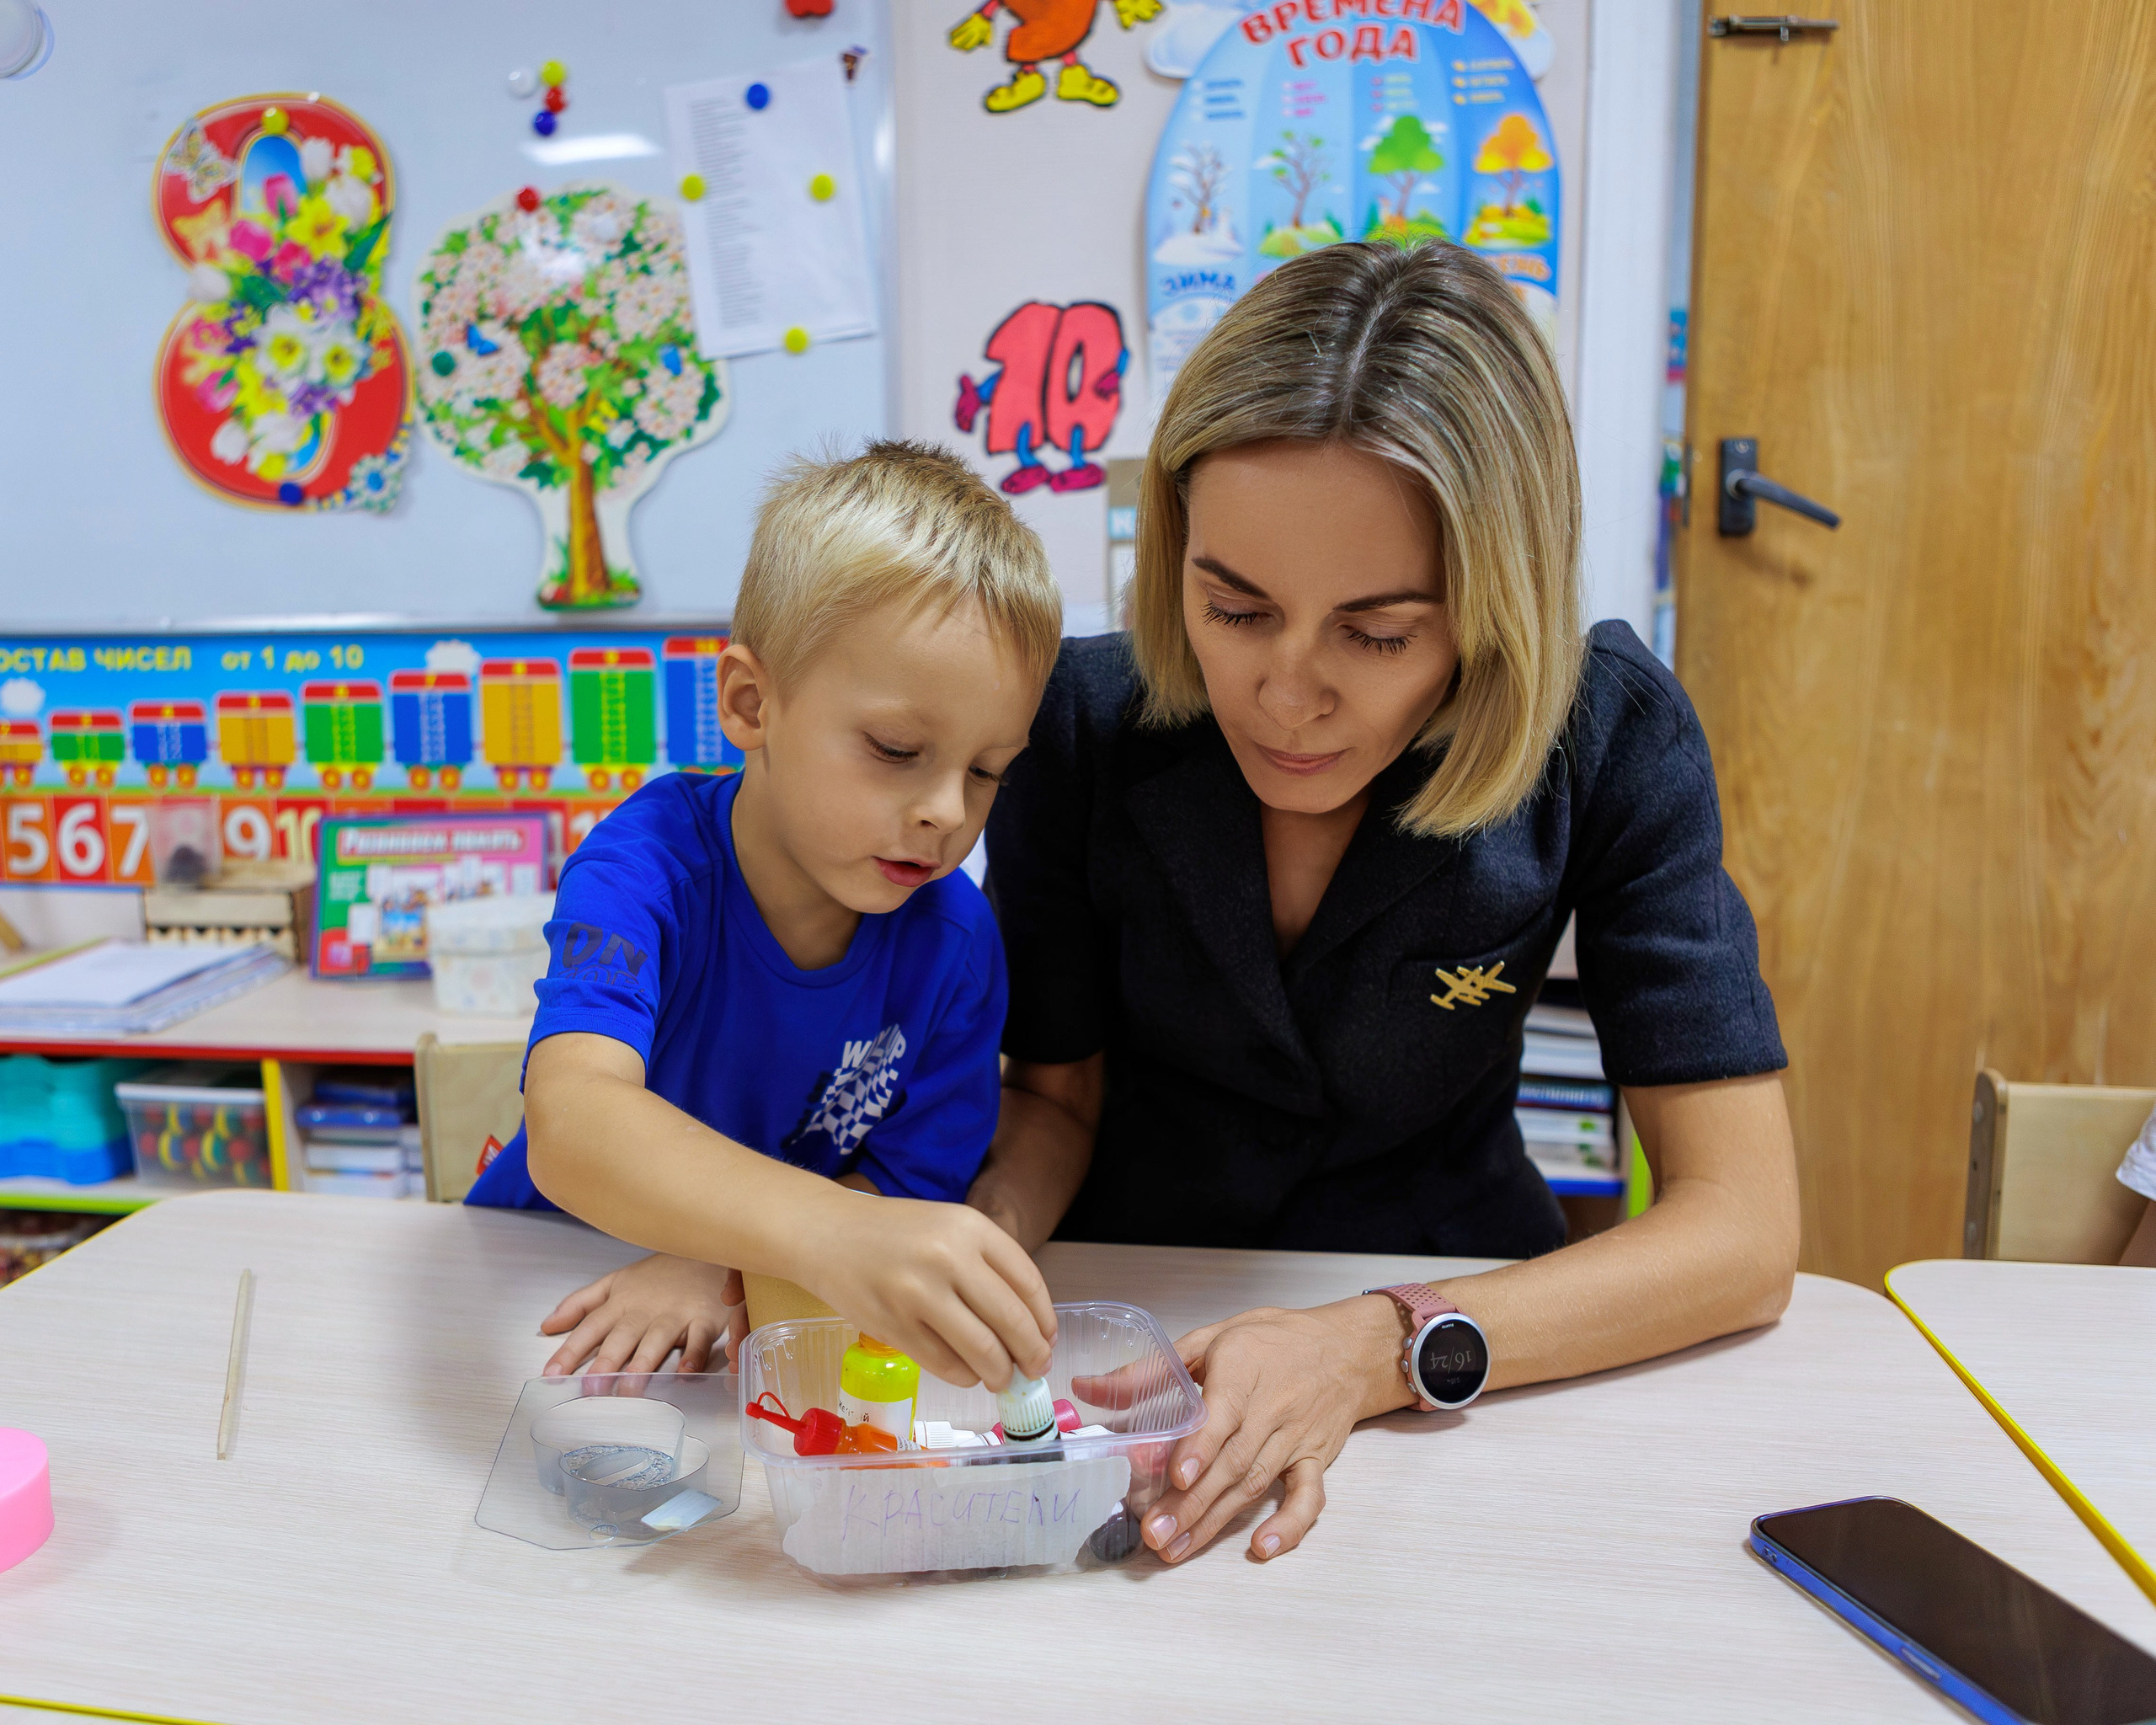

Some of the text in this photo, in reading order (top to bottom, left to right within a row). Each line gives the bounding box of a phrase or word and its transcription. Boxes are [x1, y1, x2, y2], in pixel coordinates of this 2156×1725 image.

[1239, 0, 1465, 45] ВРЕМЕНА
[1288, 24, 1417, 68] ГОДА
[1164, 272, 1236, 295] ЗИМА
[93, 645, 192, 671] ЧИСЕЛ
[221, 650, 253, 670] от
[260, 644, 275, 670] 1
[283, 649, 321, 674] до
[329, 644, 364, 670] 10
[7, 803, 51, 877] 5
[56, 802, 106, 878] 6
[110, 804, 150, 879] 7
[225, 806, 270, 862] 9
[1430, 1346, 1472, 1375] 16/24
[842, 1484, 1081, 1541] КРАСИТЕЛИ
